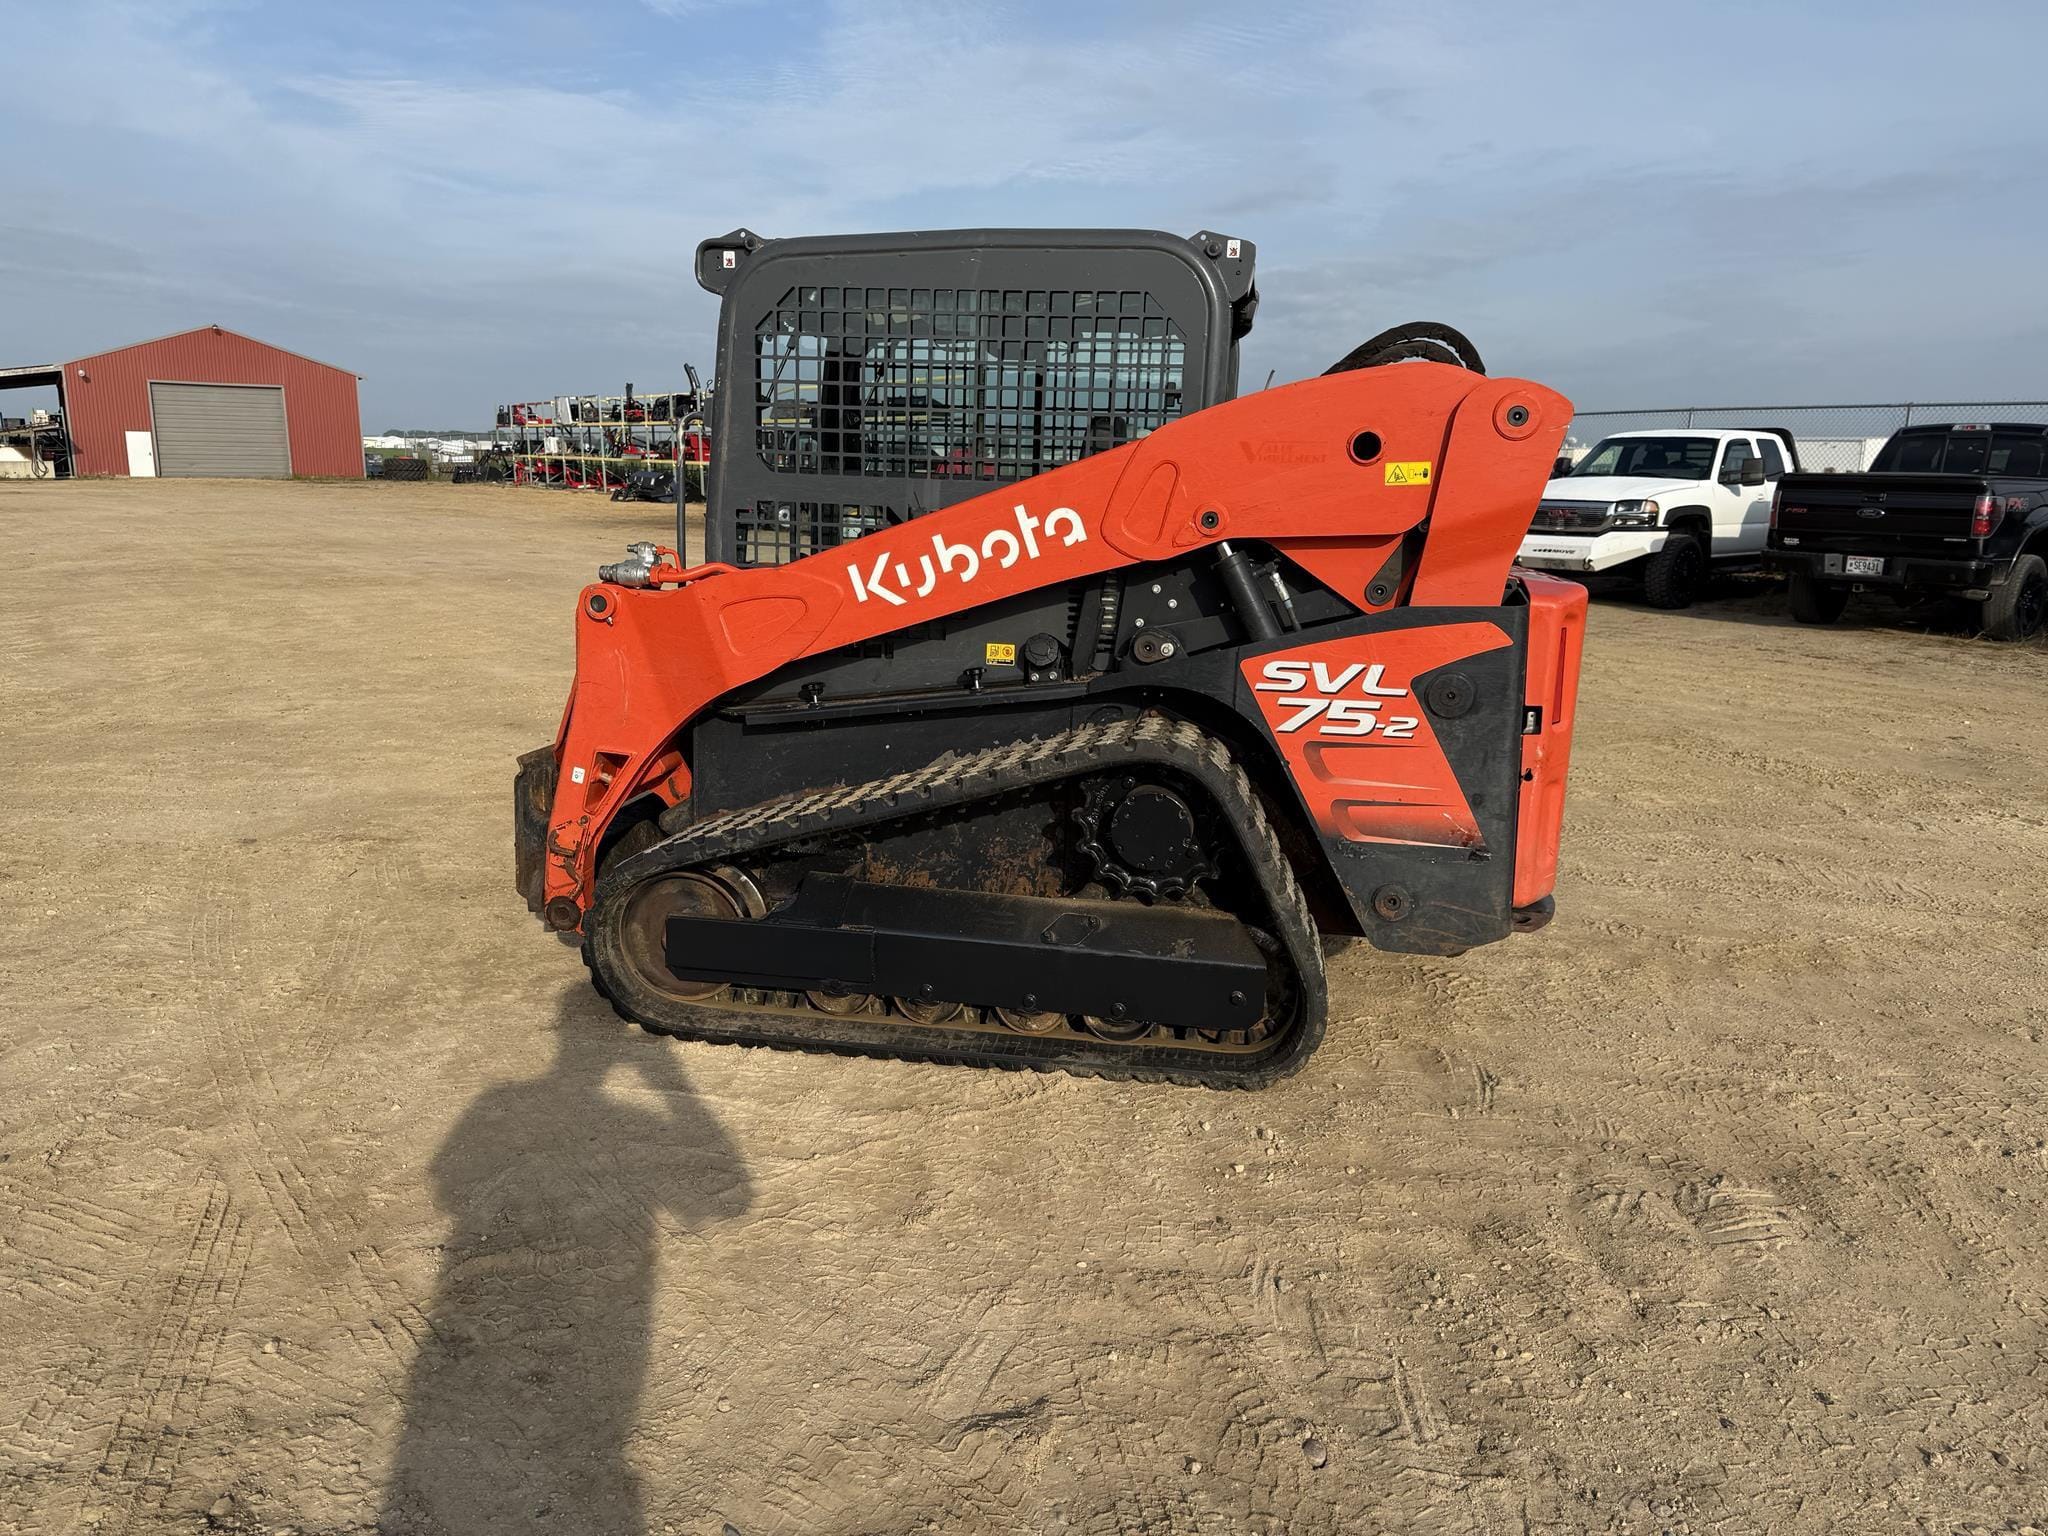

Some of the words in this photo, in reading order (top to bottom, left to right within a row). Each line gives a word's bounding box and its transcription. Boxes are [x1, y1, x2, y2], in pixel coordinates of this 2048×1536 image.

[847, 504, 1089, 606] Kubota
[1254, 661, 1409, 697] SVL
[1276, 697, 1420, 738] 75-2
